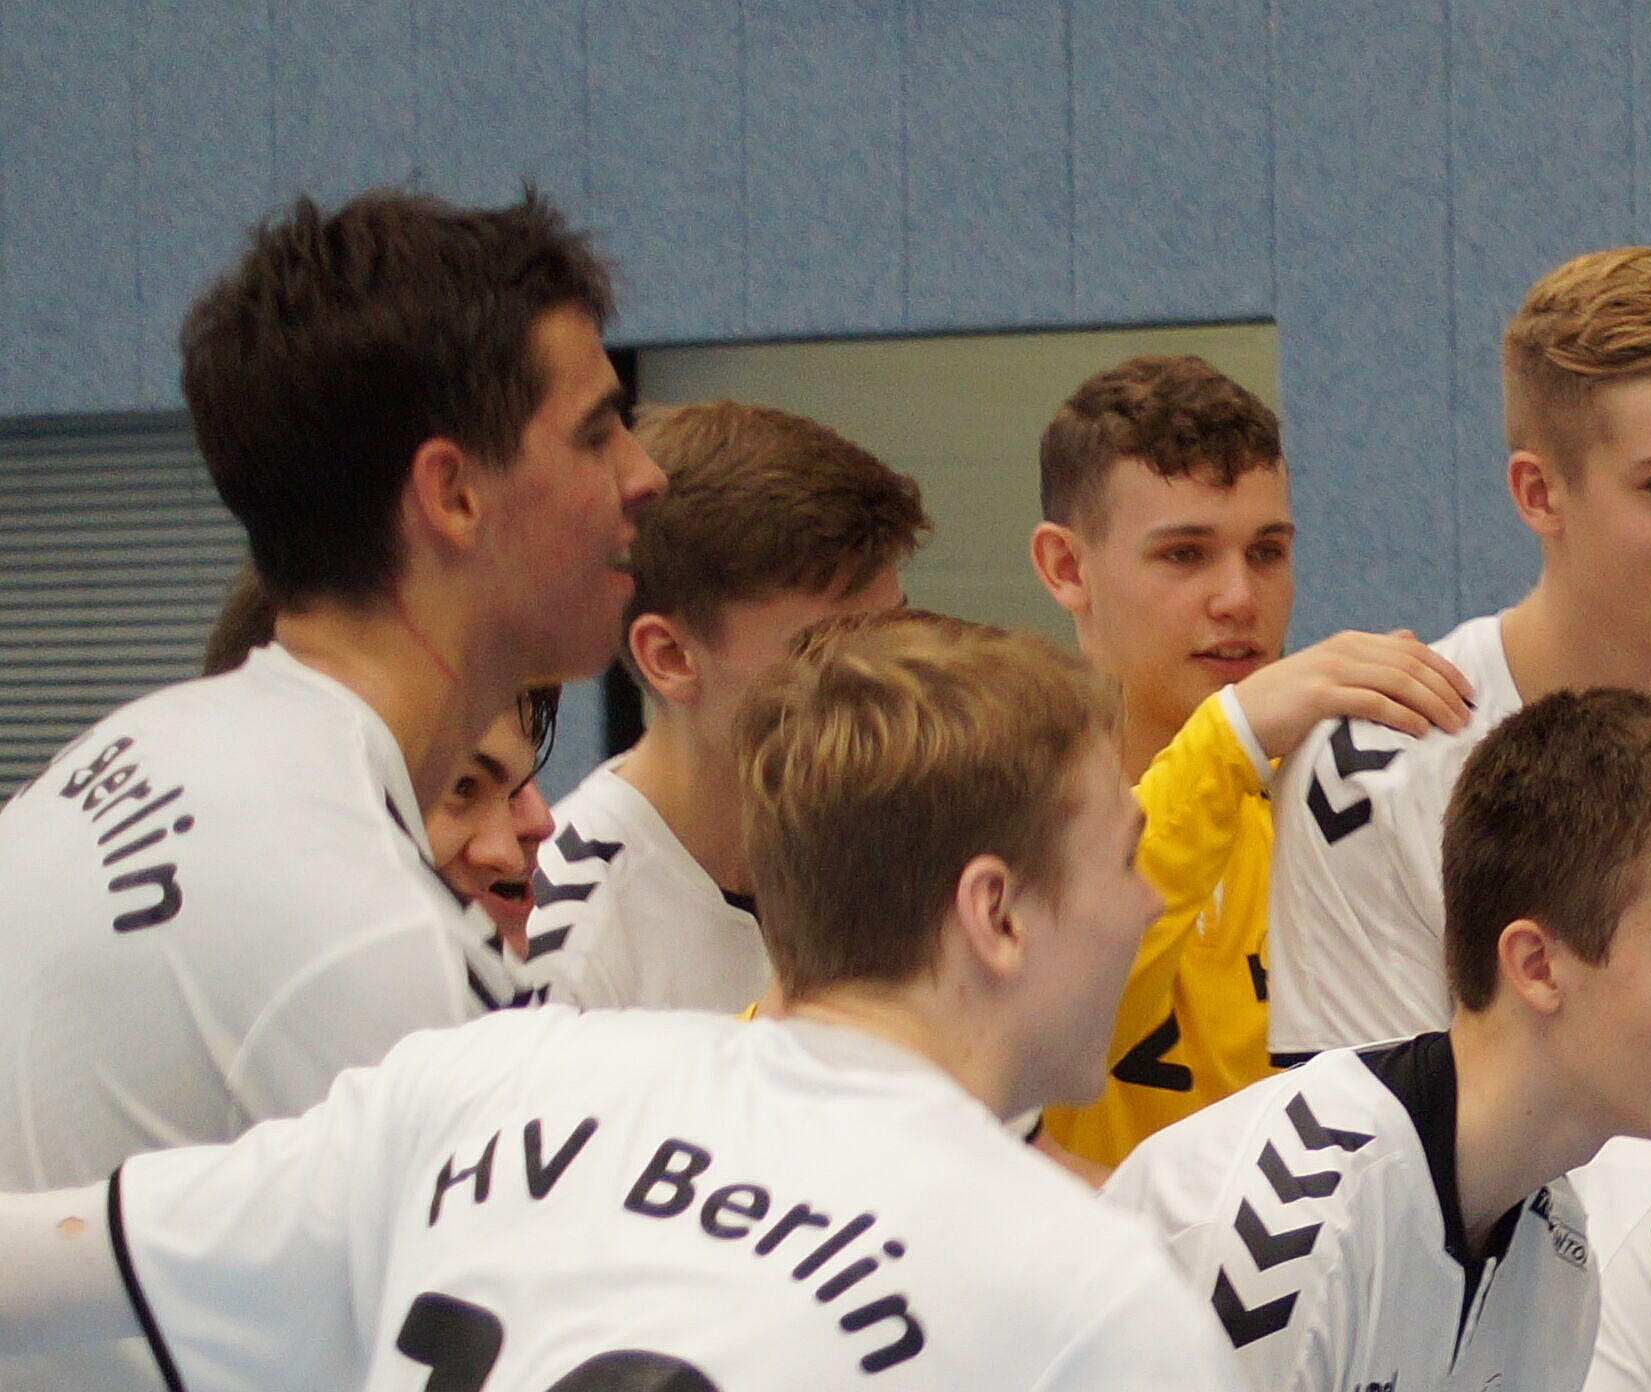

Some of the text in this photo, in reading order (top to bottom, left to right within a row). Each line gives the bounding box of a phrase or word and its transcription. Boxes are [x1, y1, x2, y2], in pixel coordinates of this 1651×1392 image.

[59, 736, 196, 934] Berlin
[428, 1117, 926, 1375] HV Berlin
